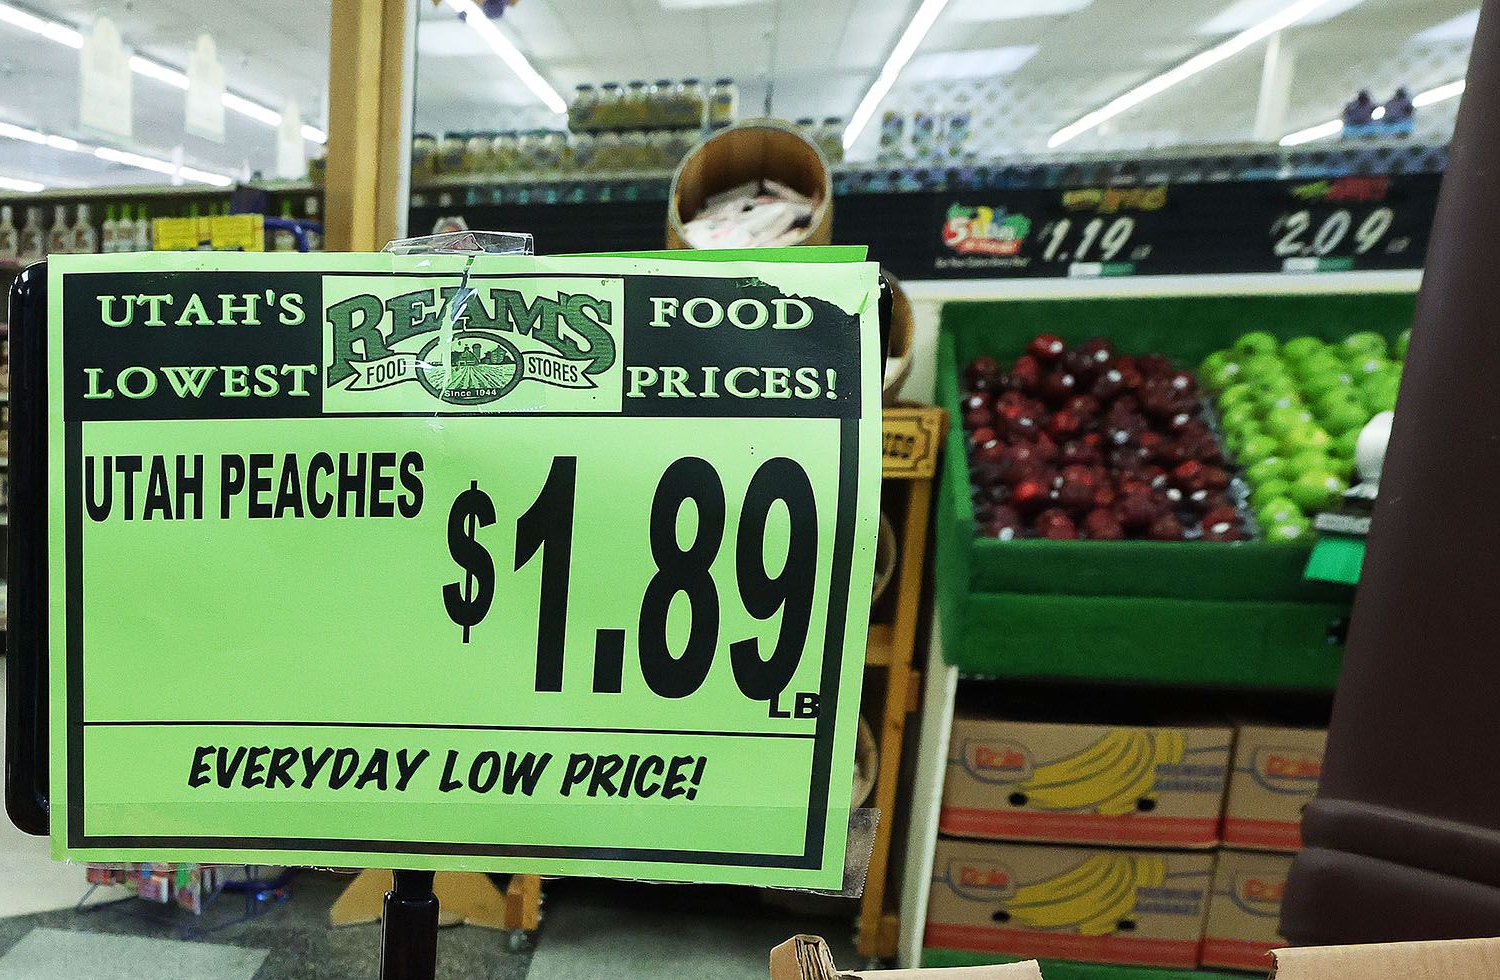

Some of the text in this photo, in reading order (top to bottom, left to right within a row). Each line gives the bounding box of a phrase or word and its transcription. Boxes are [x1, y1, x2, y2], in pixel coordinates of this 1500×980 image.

[96, 289, 306, 328] UTAH'S
[649, 296, 815, 330] FOOD
[83, 363, 317, 399] LOWEST
[366, 356, 579, 385] FOOD STORES
[626, 366, 838, 400] PRICES!
[444, 389, 472, 397] Since
[85, 450, 425, 522] UTAH PEACHES
[442, 455, 821, 719] $1.89 LB
[187, 745, 708, 801] EVERYDAY LOW PRICE!
